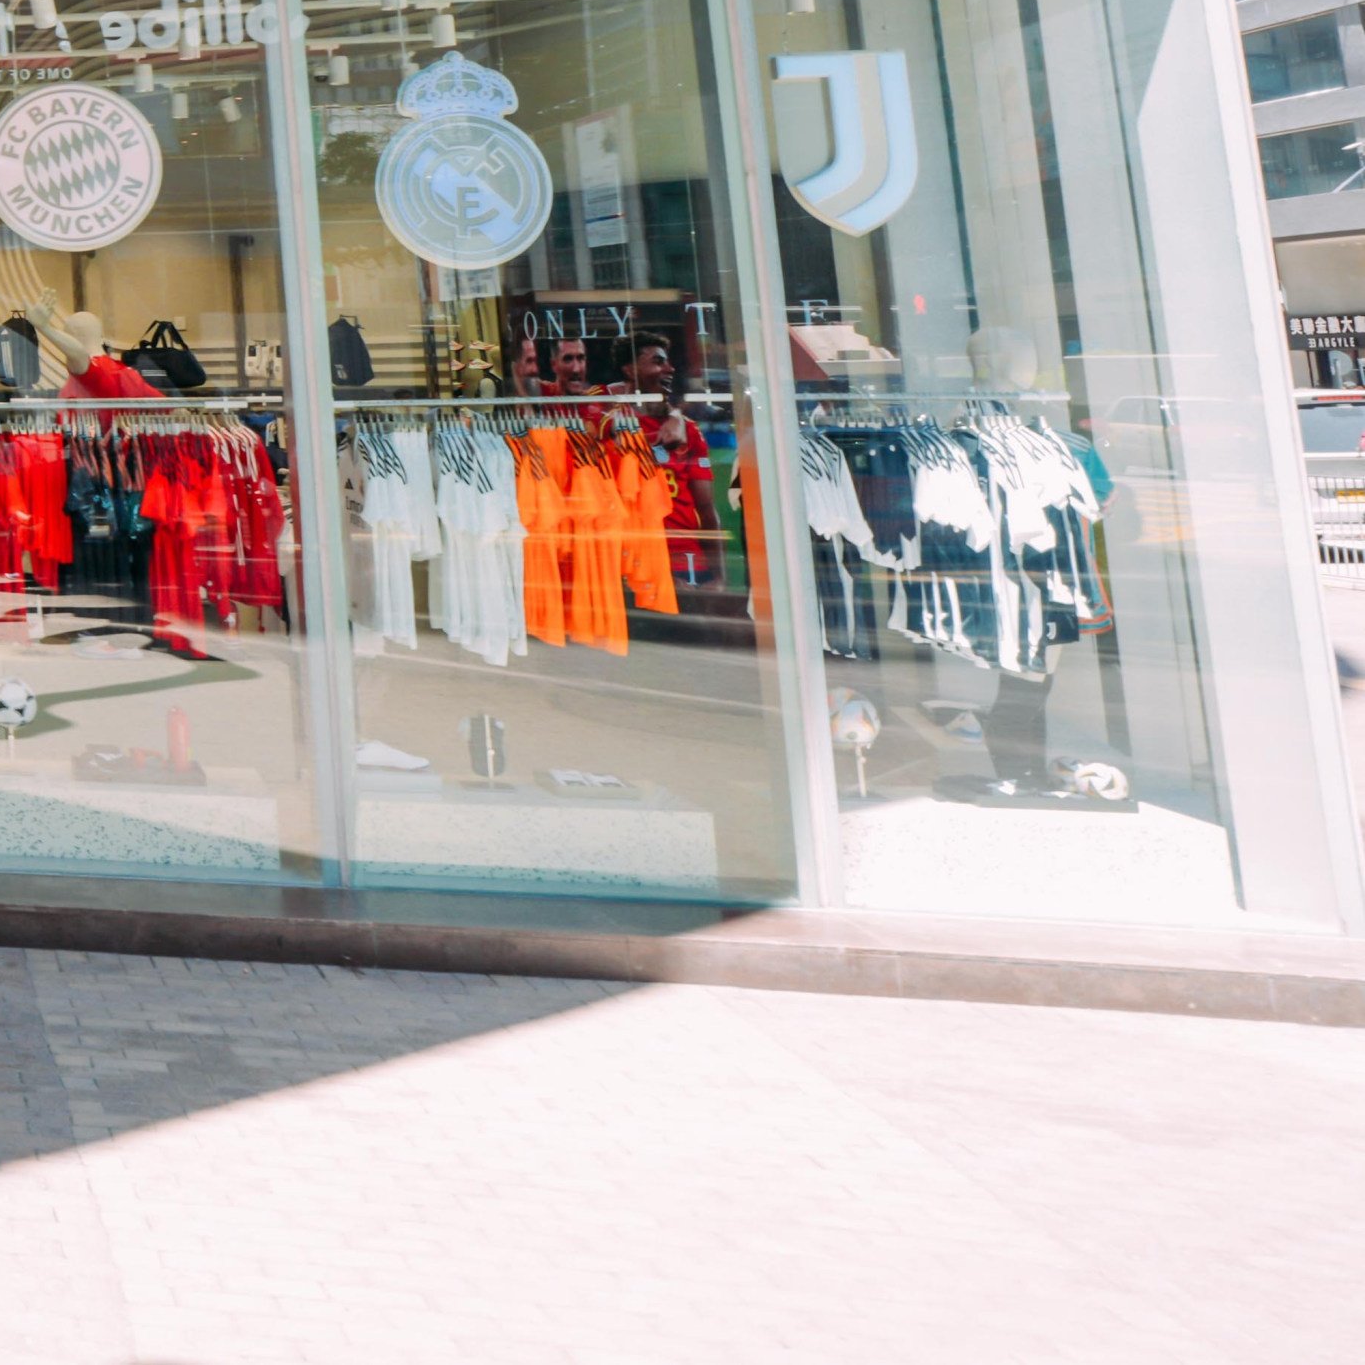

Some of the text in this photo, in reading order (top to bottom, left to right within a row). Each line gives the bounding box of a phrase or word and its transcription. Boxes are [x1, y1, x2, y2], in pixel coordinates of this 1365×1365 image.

[1, 96, 141, 160] FC BAYERN
[6, 176, 144, 235] MÜNCHEN
[1318, 337, 1356, 348] ARGYLE
